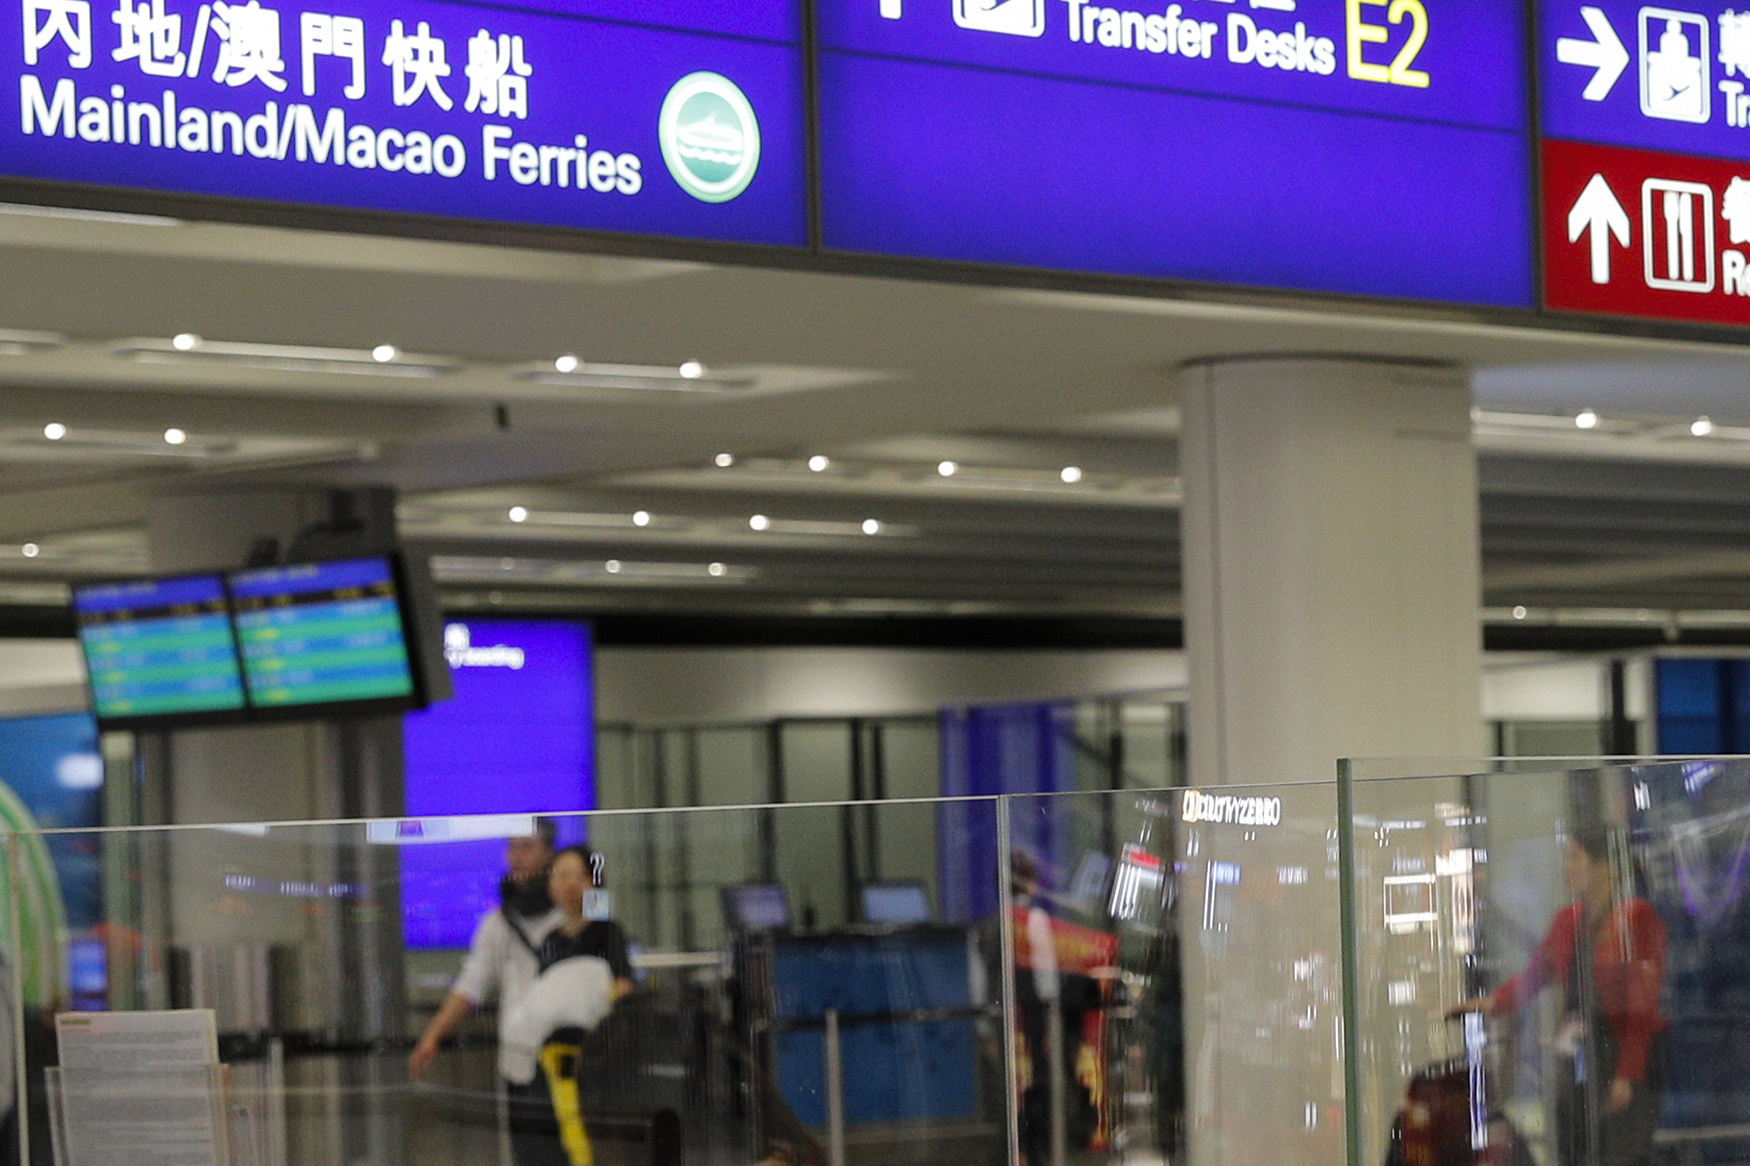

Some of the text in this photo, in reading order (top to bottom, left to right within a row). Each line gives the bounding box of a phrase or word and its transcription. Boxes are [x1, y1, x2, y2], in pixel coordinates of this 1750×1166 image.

[1059, 0, 1431, 89] Transfer Desks E2
[19, 74, 644, 196] Mainland/Macao Ferries
